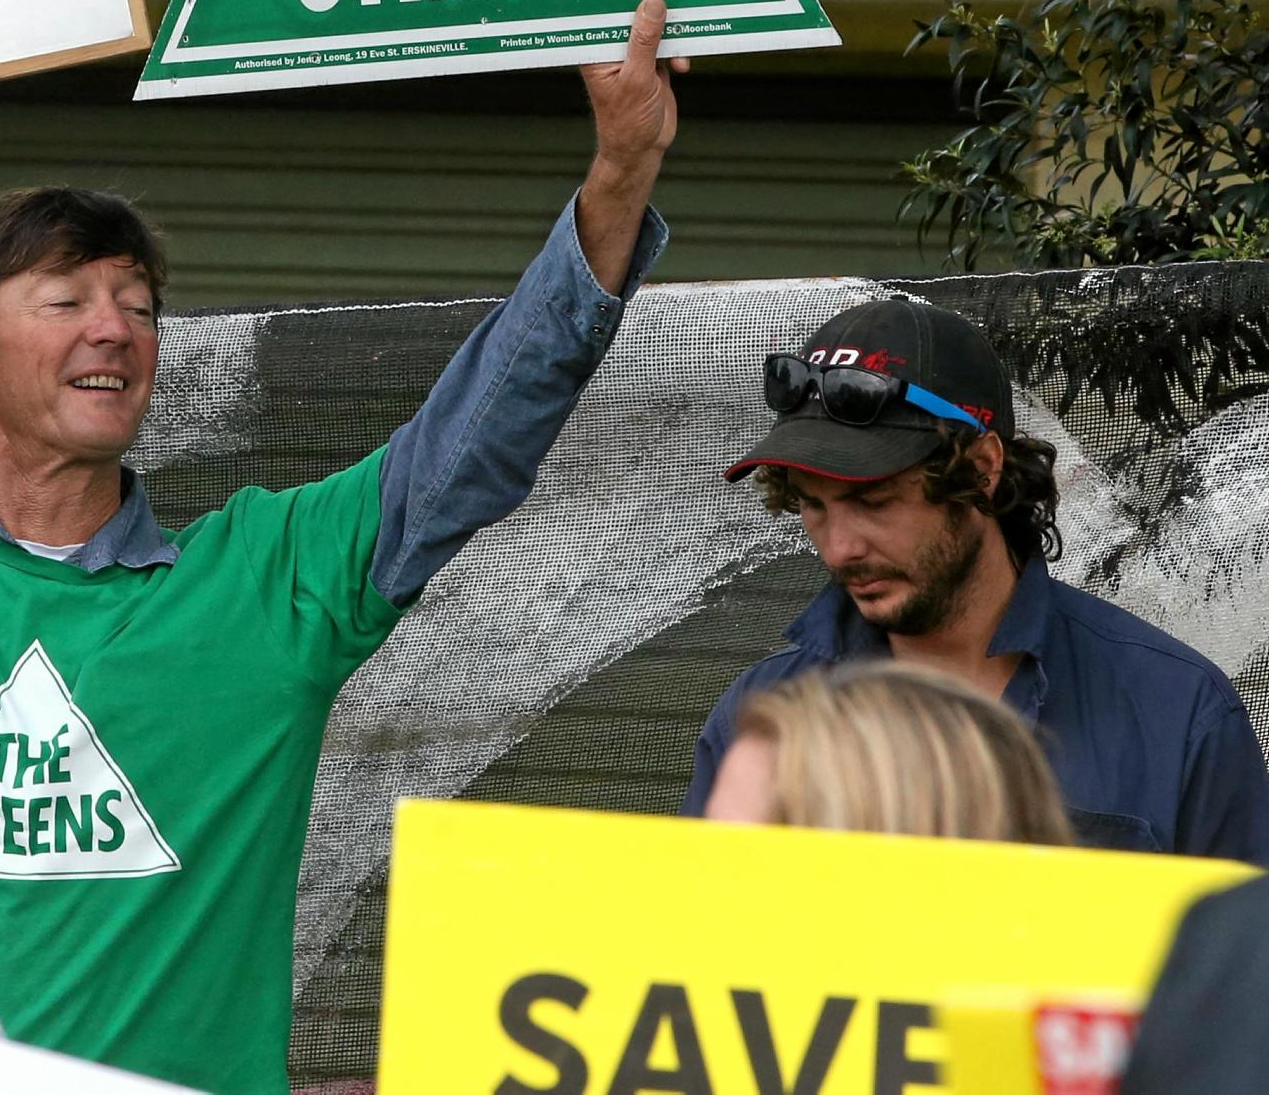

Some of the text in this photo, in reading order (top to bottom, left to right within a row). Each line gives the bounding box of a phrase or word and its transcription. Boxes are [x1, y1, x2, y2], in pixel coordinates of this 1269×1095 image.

[500, 36, 532, 48] Printed
[534, 35, 545, 46] by
[546, 32, 584, 44] Wombat
[585, 30, 610, 41] Grafx
[234, 57, 283, 70] Authorised
[284, 56, 295, 67] by
[355, 50, 367, 59] 19
[370, 49, 385, 59] Eve
[387, 47, 400, 57] St.
